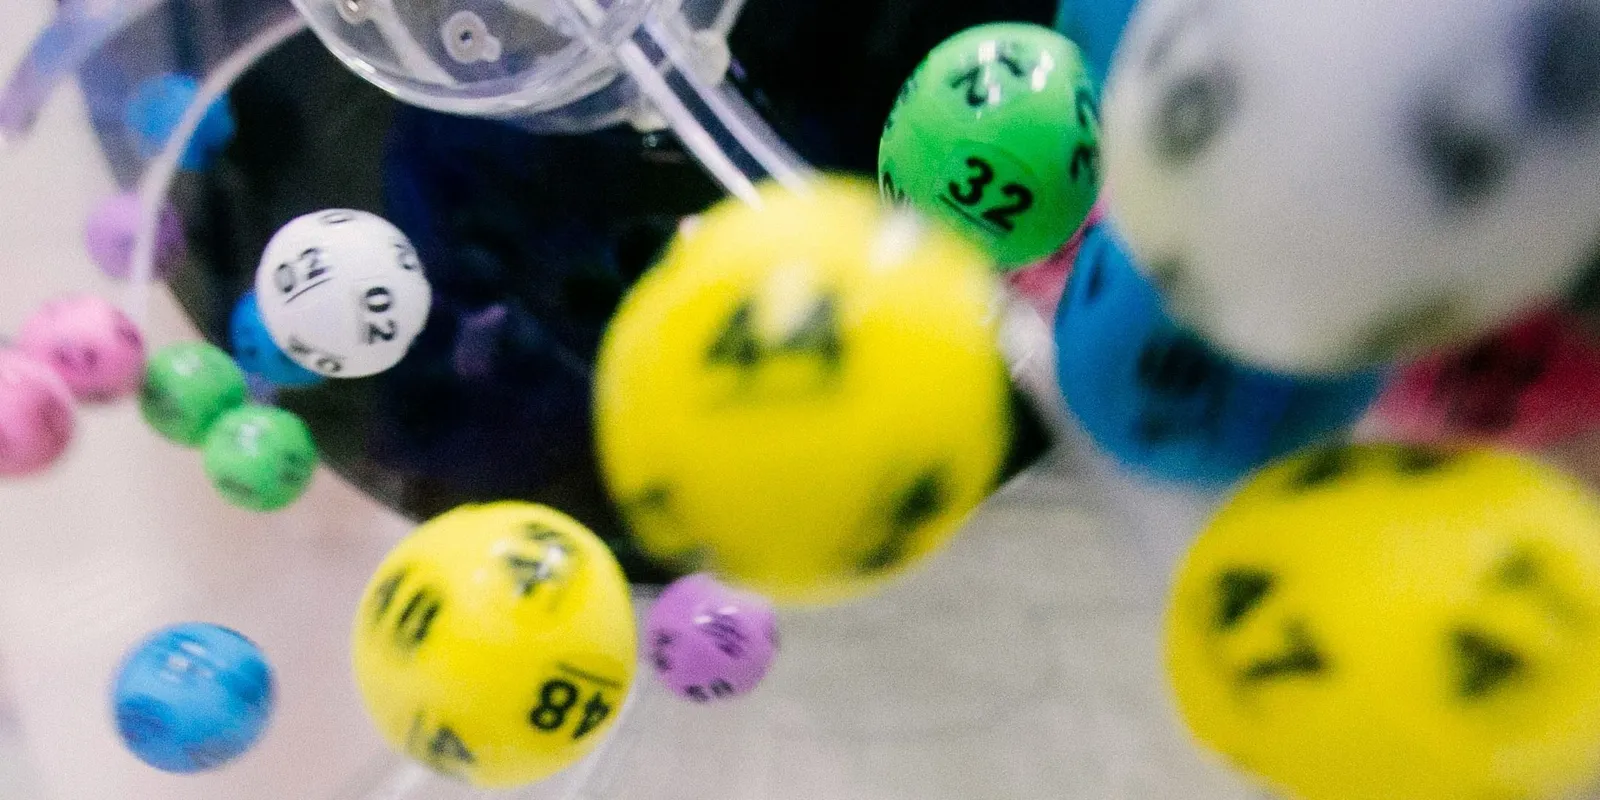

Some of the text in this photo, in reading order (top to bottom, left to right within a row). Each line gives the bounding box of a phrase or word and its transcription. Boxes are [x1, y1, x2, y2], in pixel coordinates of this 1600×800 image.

[948, 156, 1034, 232] 32
[365, 287, 397, 345] 02
[703, 291, 846, 373] 44
[528, 678, 612, 741] 48
